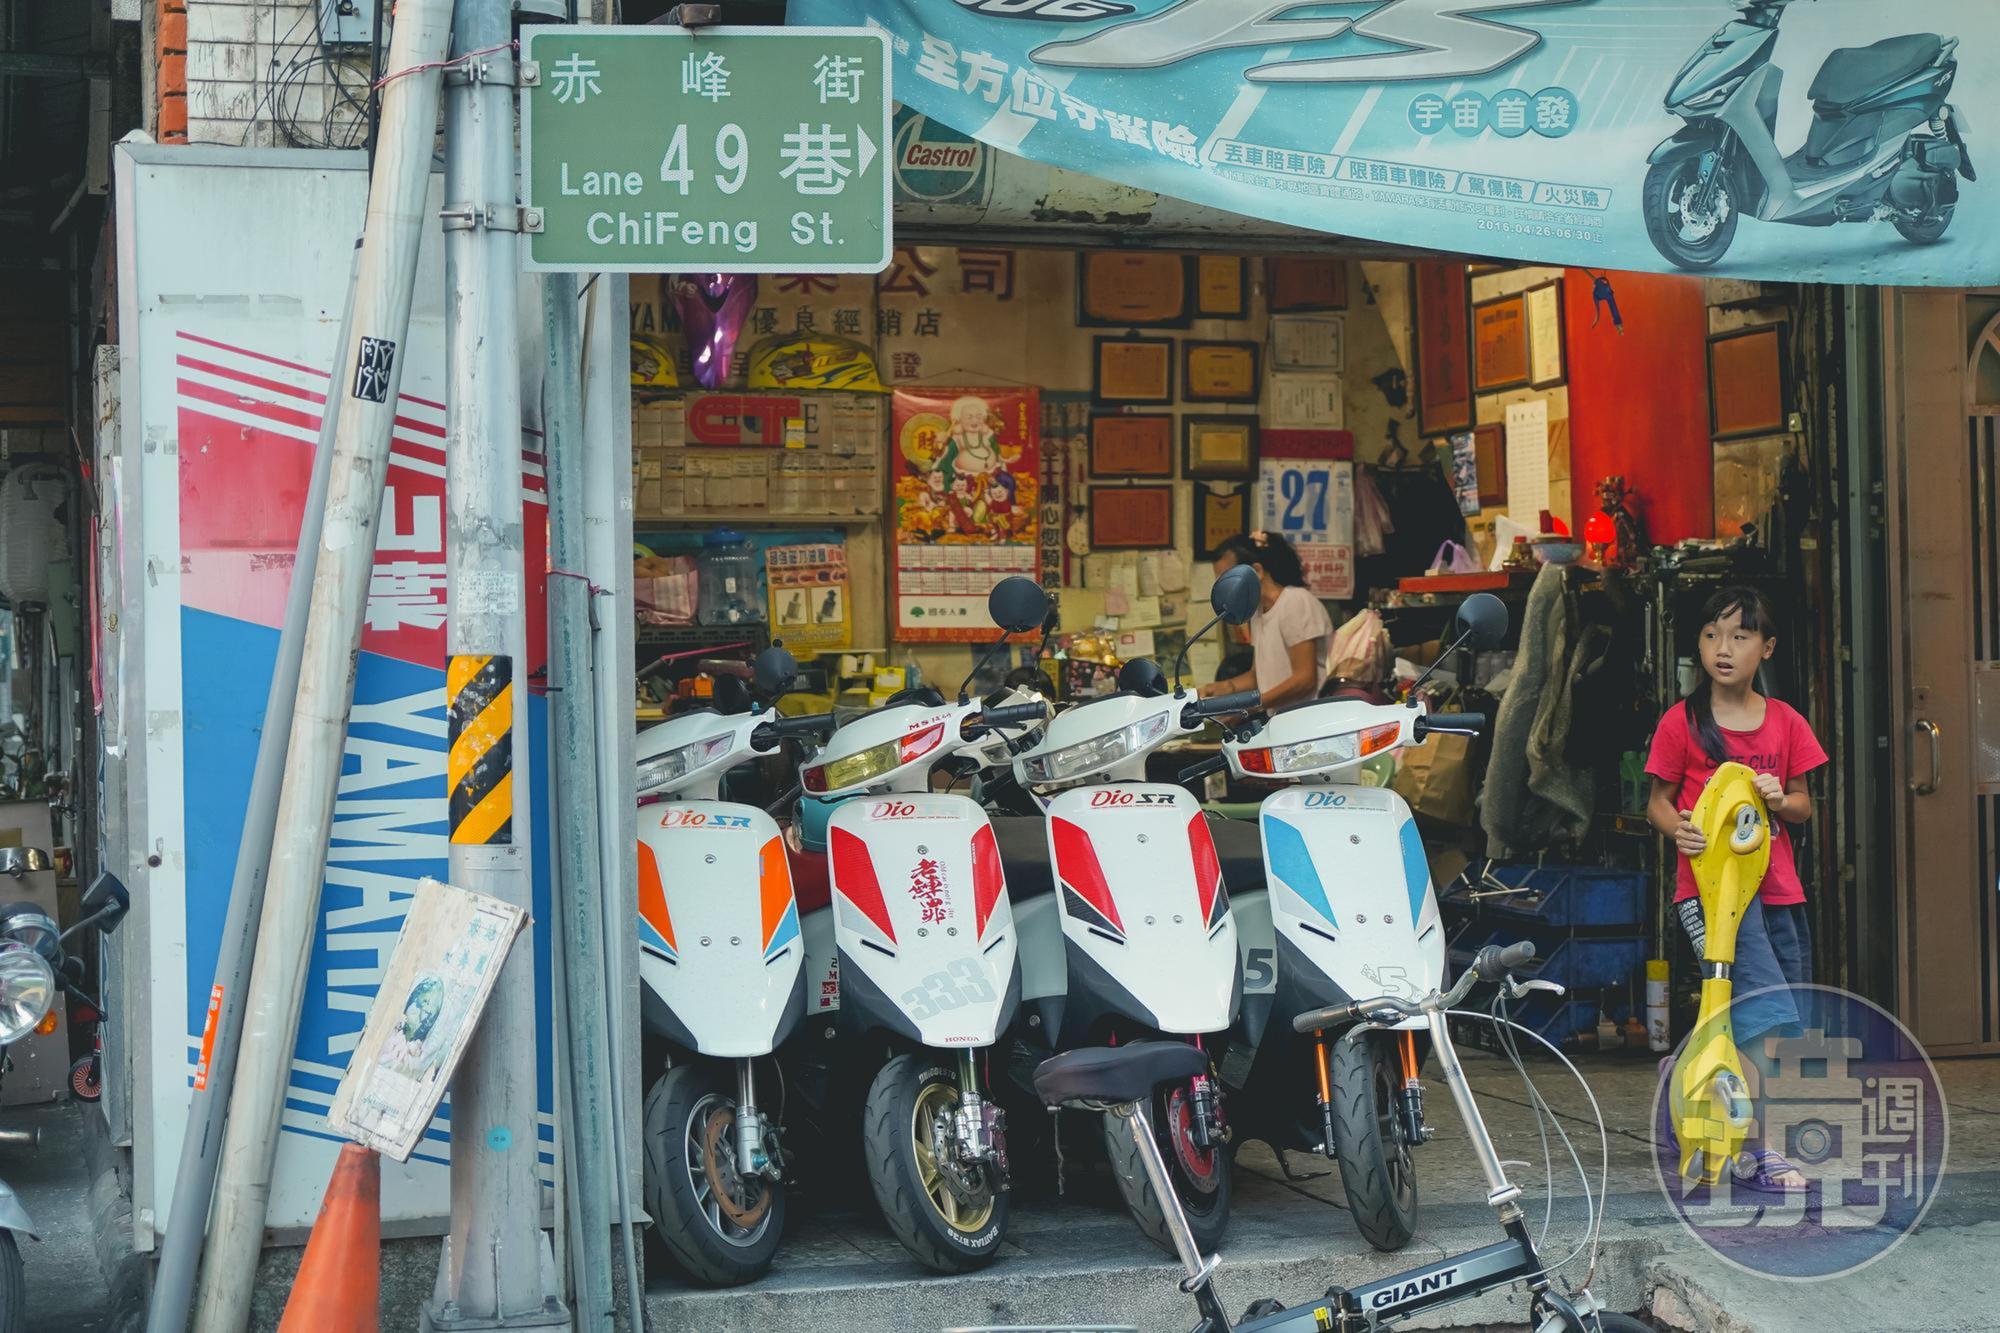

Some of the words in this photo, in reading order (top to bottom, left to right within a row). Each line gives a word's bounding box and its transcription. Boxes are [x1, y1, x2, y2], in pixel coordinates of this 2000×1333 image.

[551, 52, 865, 104] 赤峰街
[1415, 96, 1571, 130] 宇宙首發
[561, 163, 643, 196] Lane
[660, 123, 749, 196] 49
[778, 123, 853, 195] 巷
[906, 143, 977, 168] Castrol
[1349, 161, 1446, 191] 限額車體險
[1544, 186, 1600, 208] 火災險
[586, 211, 758, 253] ChiFeng
[791, 211, 845, 246] St.
[752, 305, 942, 337] 優良經銷店
[1281, 469, 1330, 531] 27
[1749, 753, 1778, 770] CLU
[871, 801, 916, 820] Dio
[1090, 790, 1134, 808] Dio
[1304, 790, 1347, 808] Dio
[660, 808, 706, 827] Dio
[1244, 948, 1274, 990] 5
[901, 957, 997, 1021] 333
[944, 1034, 981, 1043] HONDA
[918, 1066, 957, 1085] BRIDGESTO
[1371, 1268, 1458, 1308] GIANT
